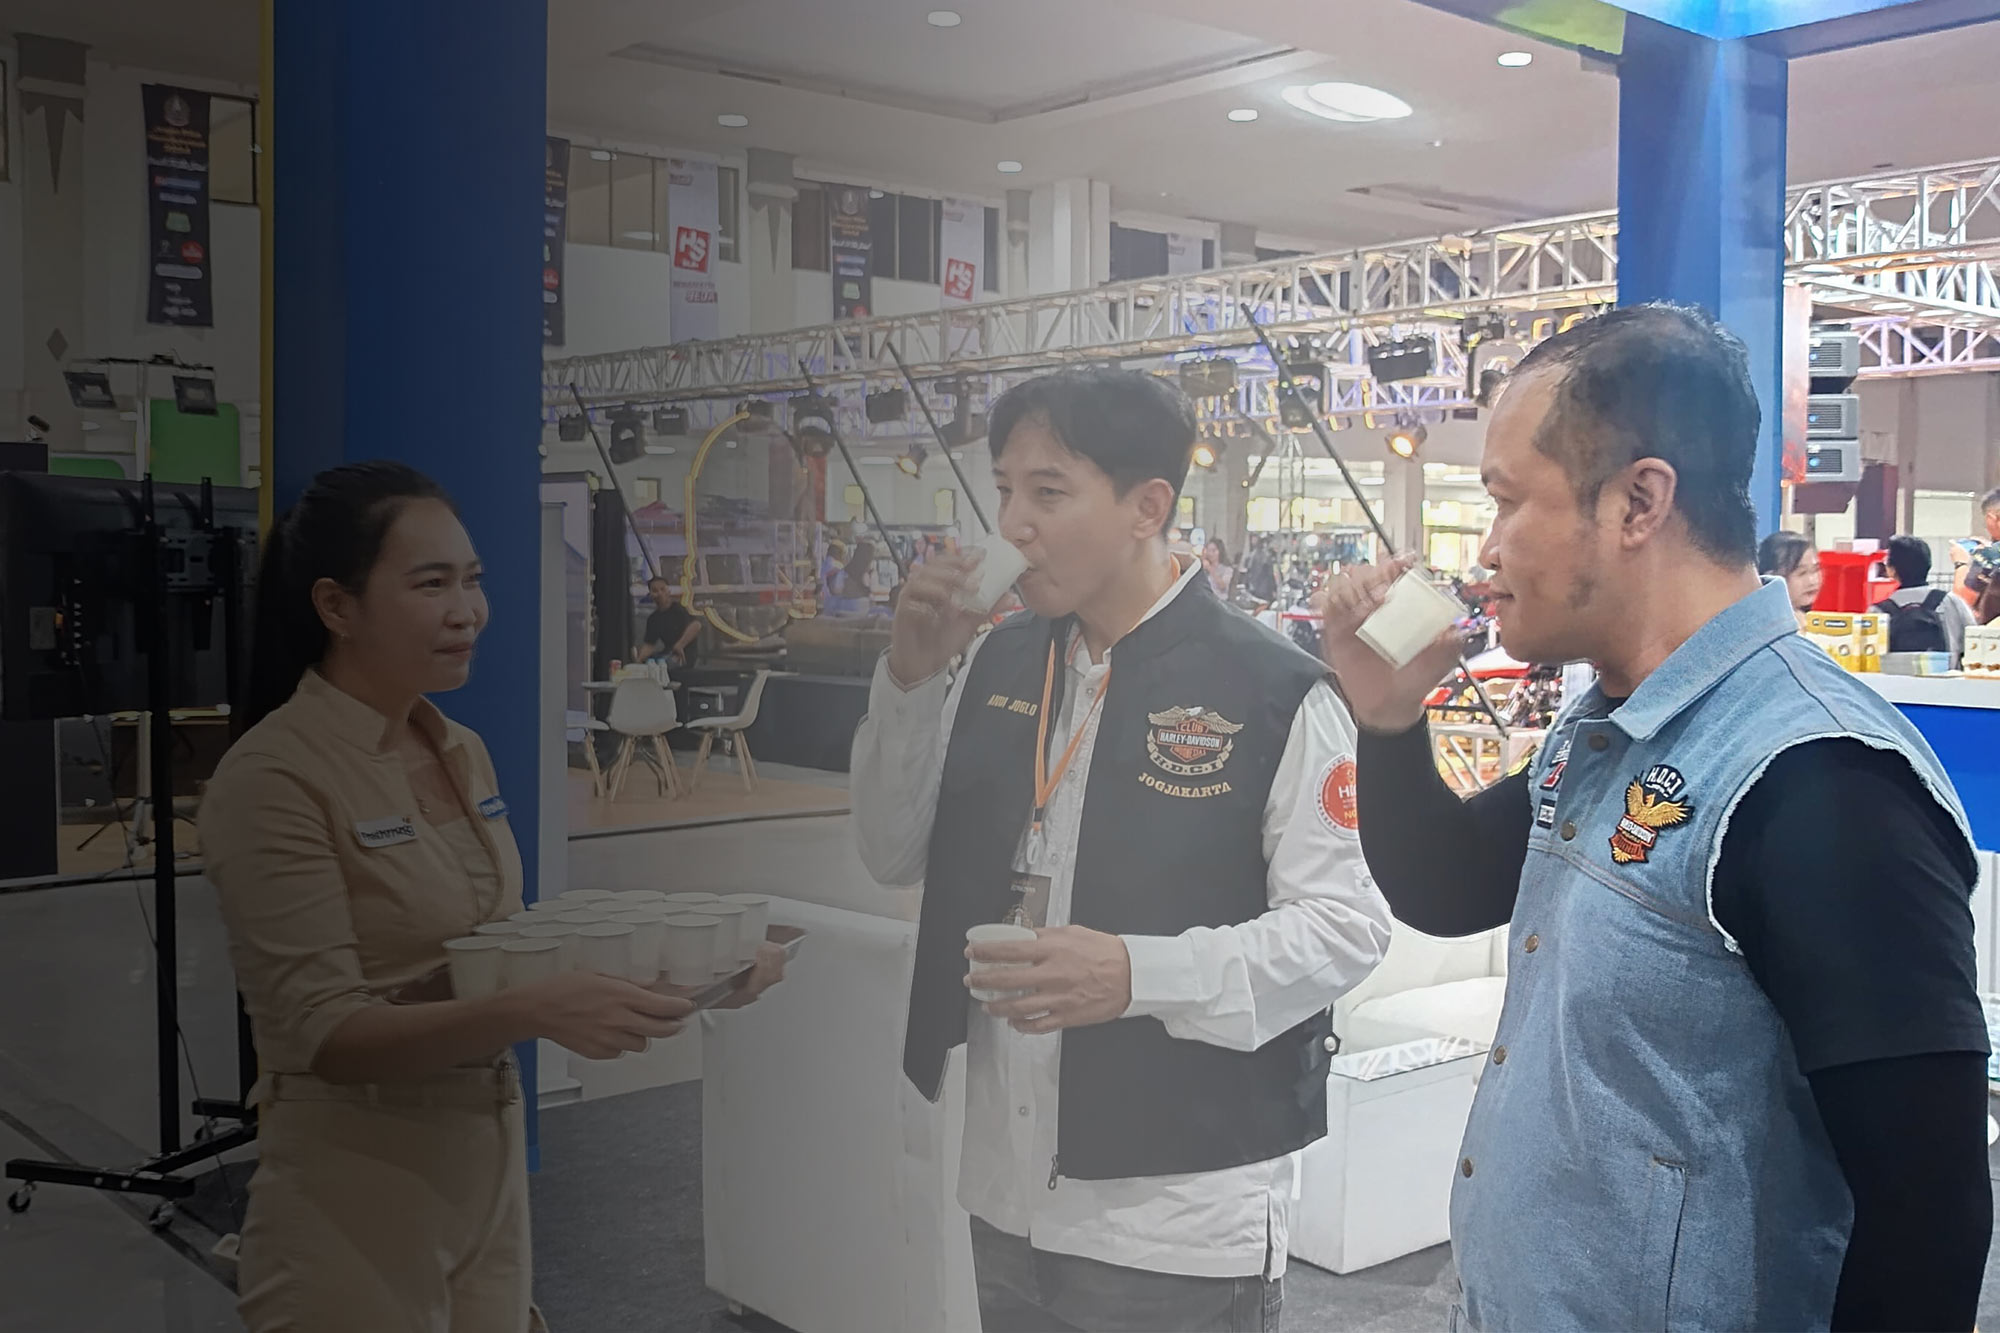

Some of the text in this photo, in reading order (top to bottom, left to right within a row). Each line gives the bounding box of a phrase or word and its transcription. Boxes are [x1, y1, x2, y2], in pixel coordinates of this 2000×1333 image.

[1008, 699, 1039, 717] JOGLO
[1180, 722, 1204, 733] CLUB
[1159, 732, 1221, 748] HARLEY-DAVIDSON
[1138, 772, 1232, 798] JOGJAKARTA
